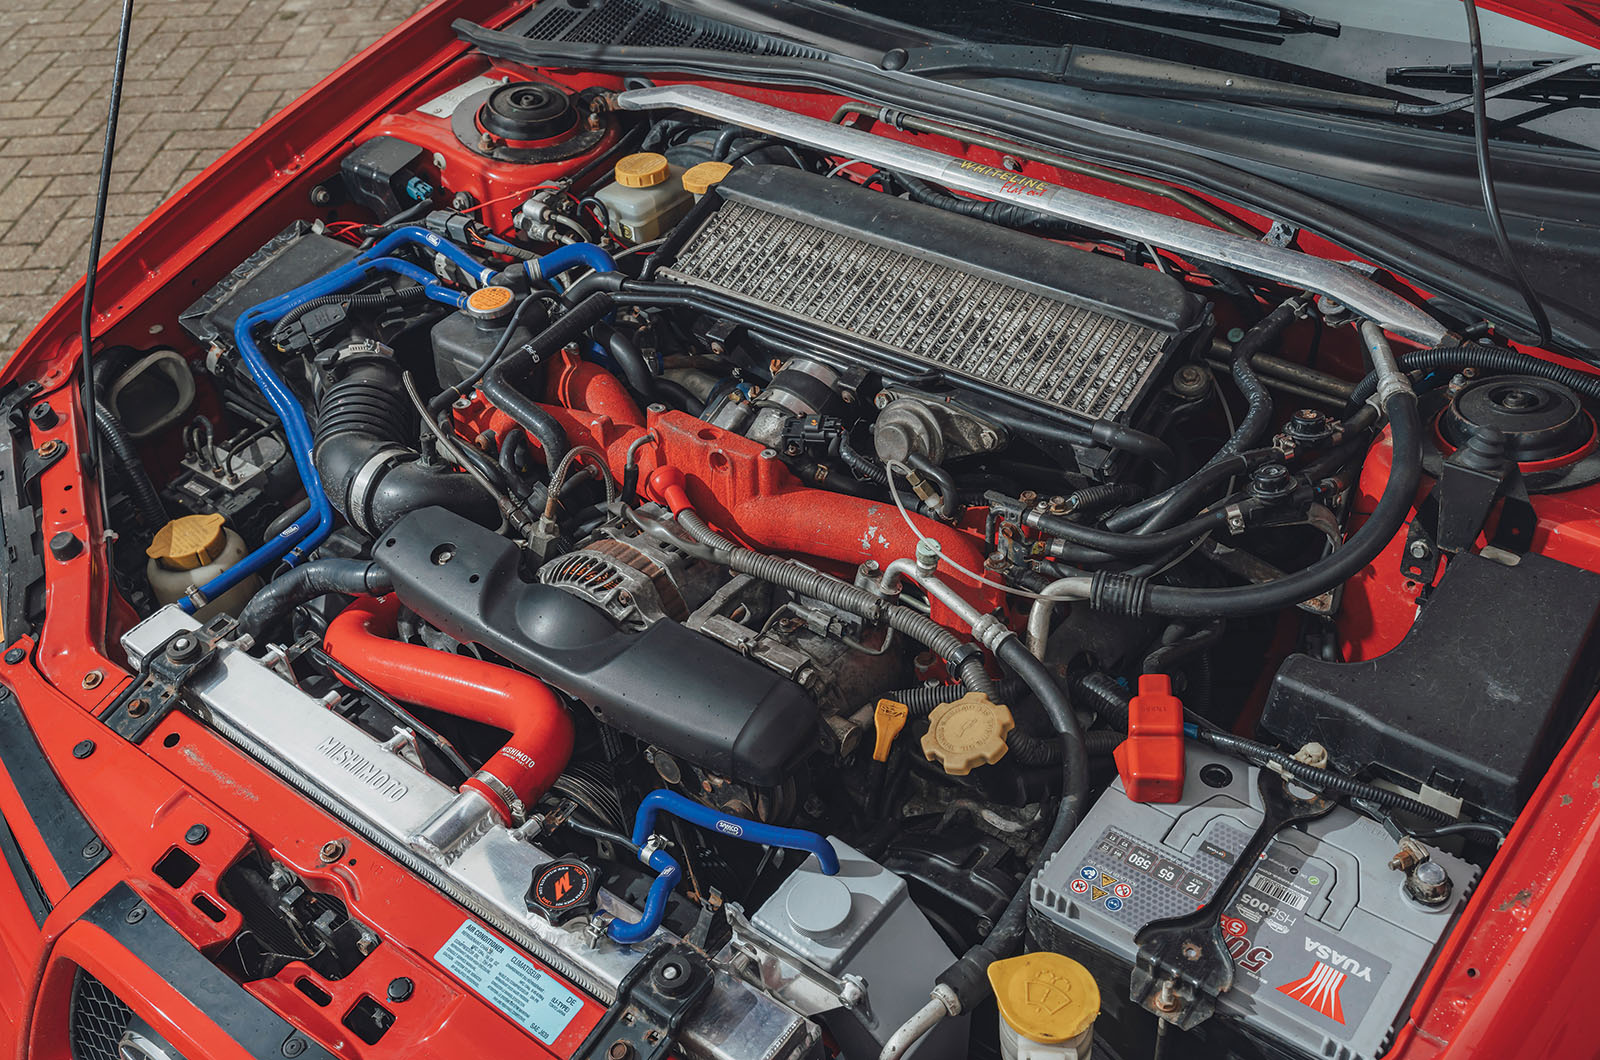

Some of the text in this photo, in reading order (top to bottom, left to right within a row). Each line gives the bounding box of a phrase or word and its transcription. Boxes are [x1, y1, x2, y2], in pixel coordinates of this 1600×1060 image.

[960, 160, 1049, 191] WHITELINE
[316, 737, 409, 803] MISHIMOTO
[1128, 853, 1151, 870] 580
[1158, 867, 1175, 882] 65
[1186, 881, 1201, 895] 12
[1240, 893, 1296, 926] HSB005
[466, 923, 505, 954] AIR CONDITIONER
[509, 955, 542, 981] CLIMATISEUR
[1304, 936, 1372, 983] YUASA
[565, 996, 577, 1006] DE
[530, 1022, 541, 1033] SAE
